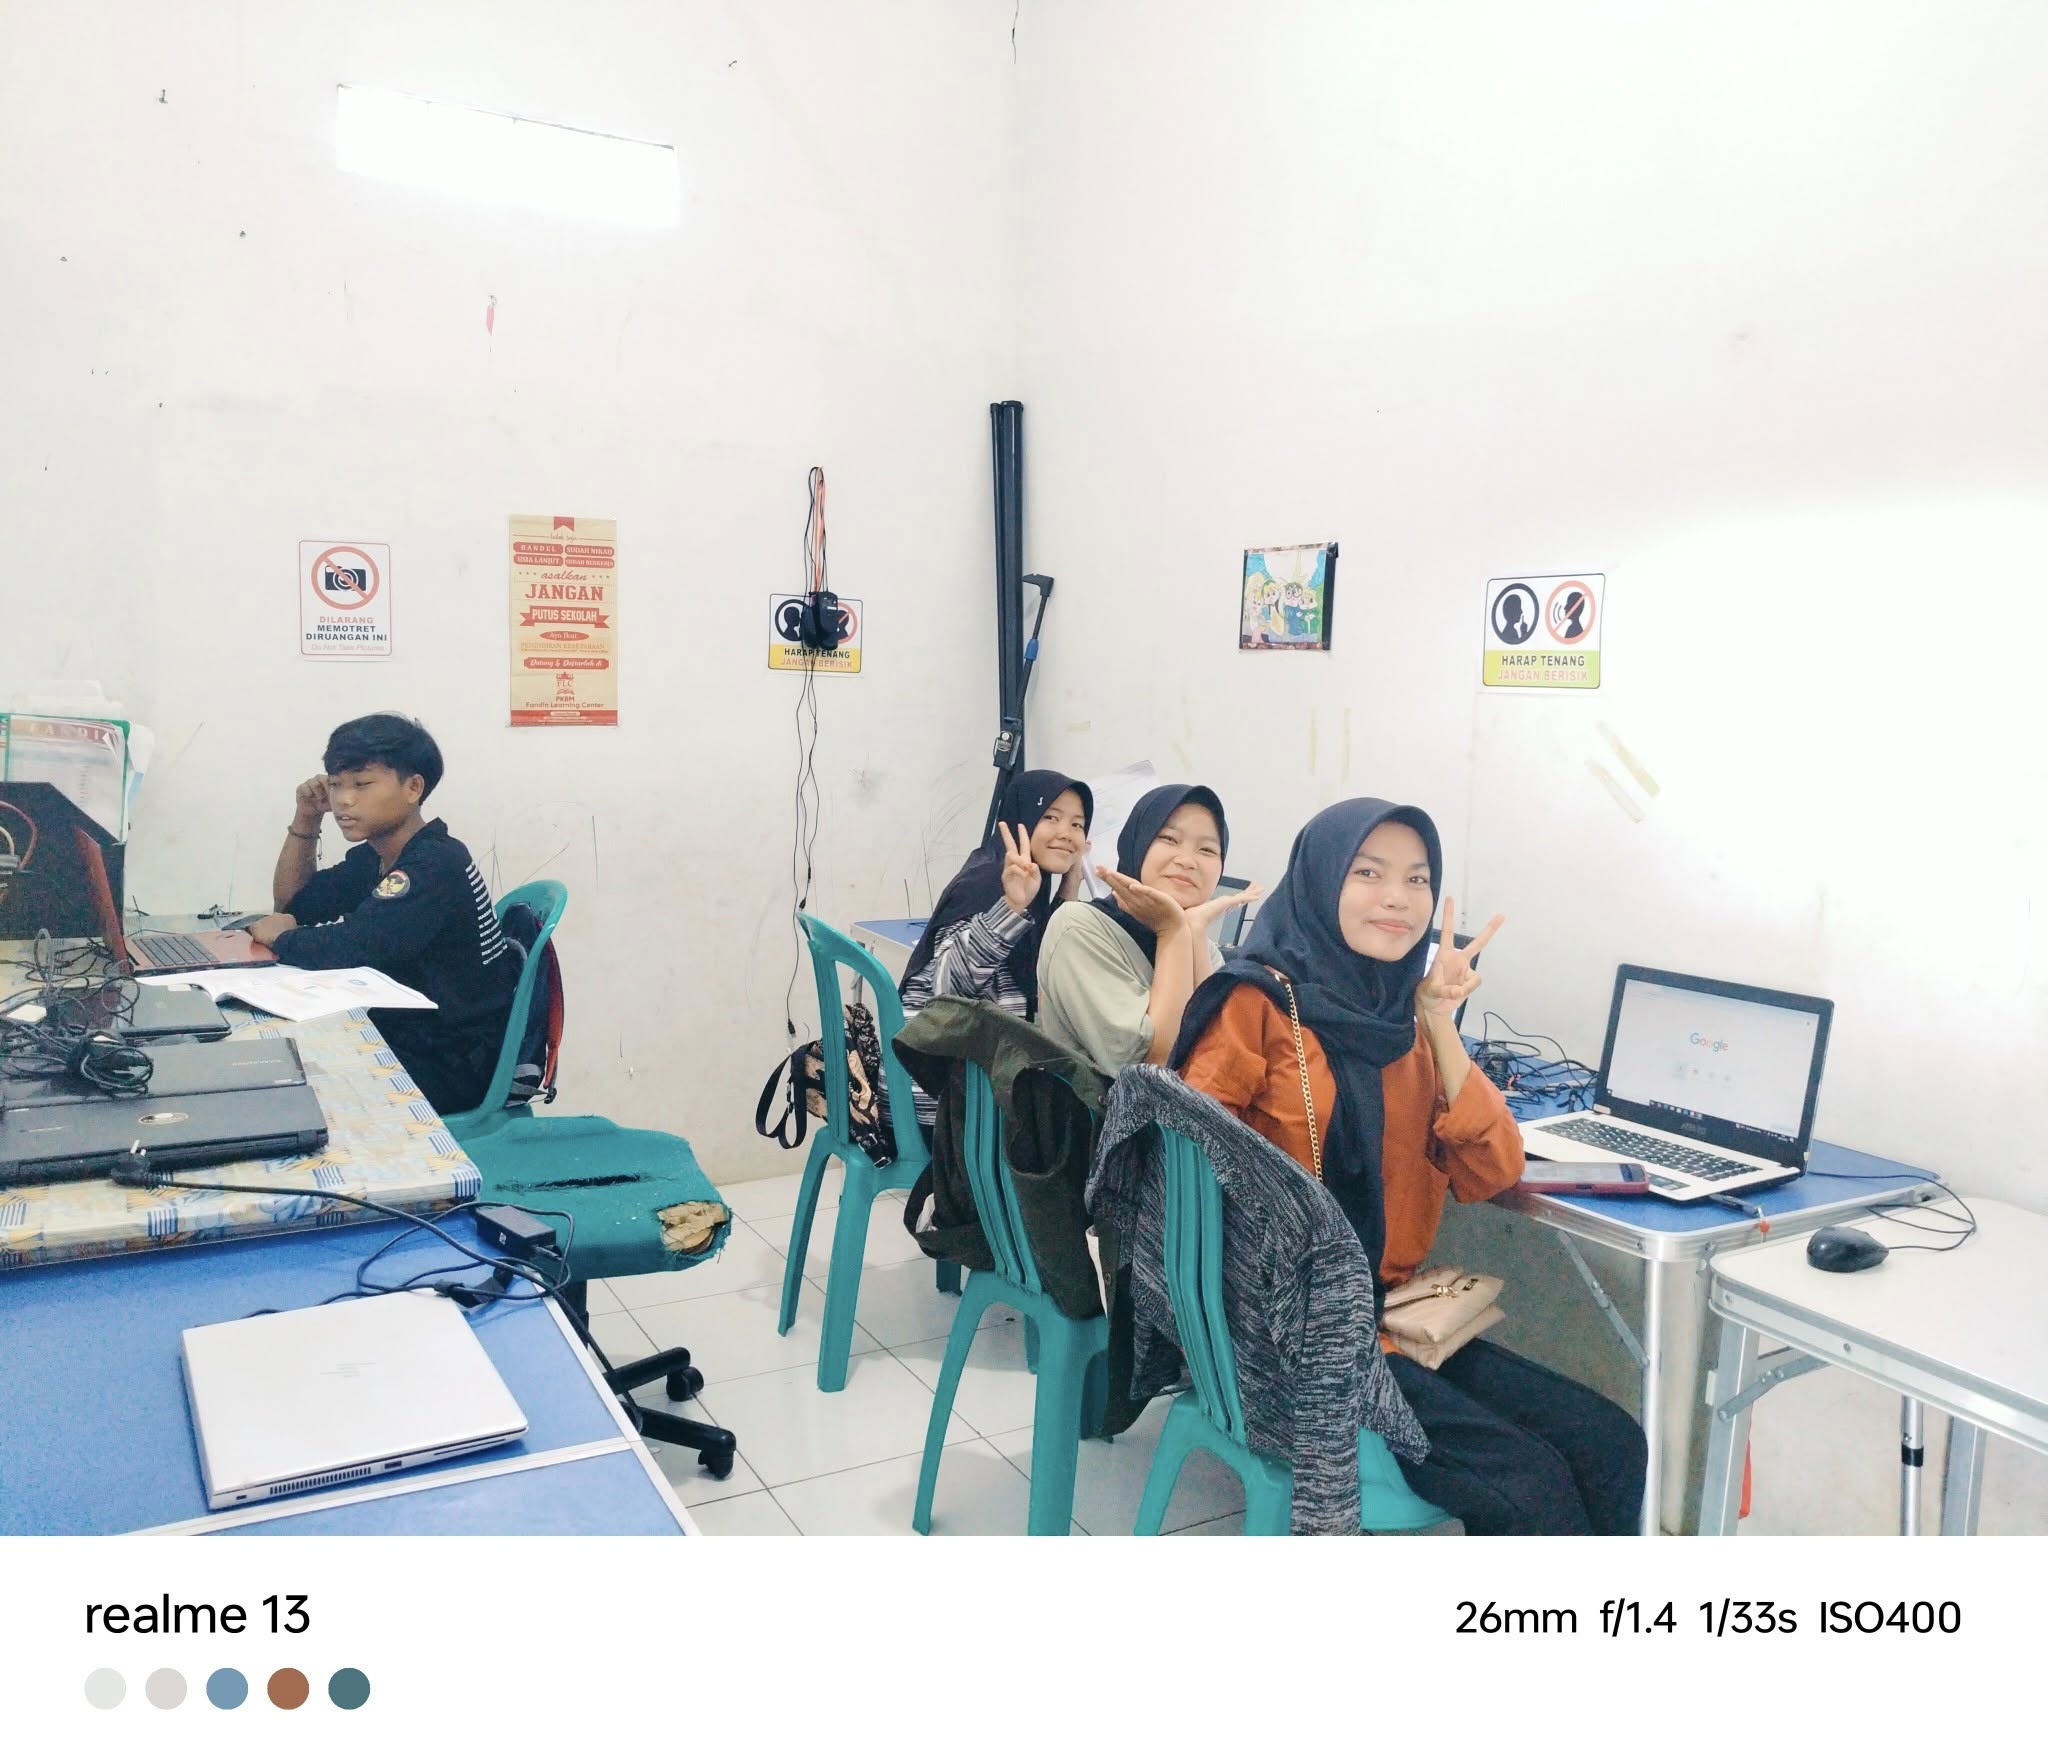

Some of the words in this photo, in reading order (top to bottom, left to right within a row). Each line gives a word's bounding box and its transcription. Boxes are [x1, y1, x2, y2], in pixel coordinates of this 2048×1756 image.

[566, 546, 590, 554] SUDAH
[540, 570, 588, 581] asalkan
[525, 584, 604, 600] JANGAN
[319, 616, 374, 624] DILARANG
[532, 608, 559, 621] PUTUS
[560, 609, 597, 622] SEKOLAH
[317, 624, 376, 633] MEMOTRET
[305, 633, 369, 641] DIRUANGAN
[372, 633, 388, 641] INI
[784, 648, 814, 657] HARAP
[815, 649, 850, 659] TENANG
[1502, 655, 1537, 666] HARAP
[1541, 655, 1585, 666] TENANG
[1498, 670, 1540, 681] JANGAN
[1544, 670, 1588, 681] BERISIK
[1690, 1032, 1729, 1052] Google
